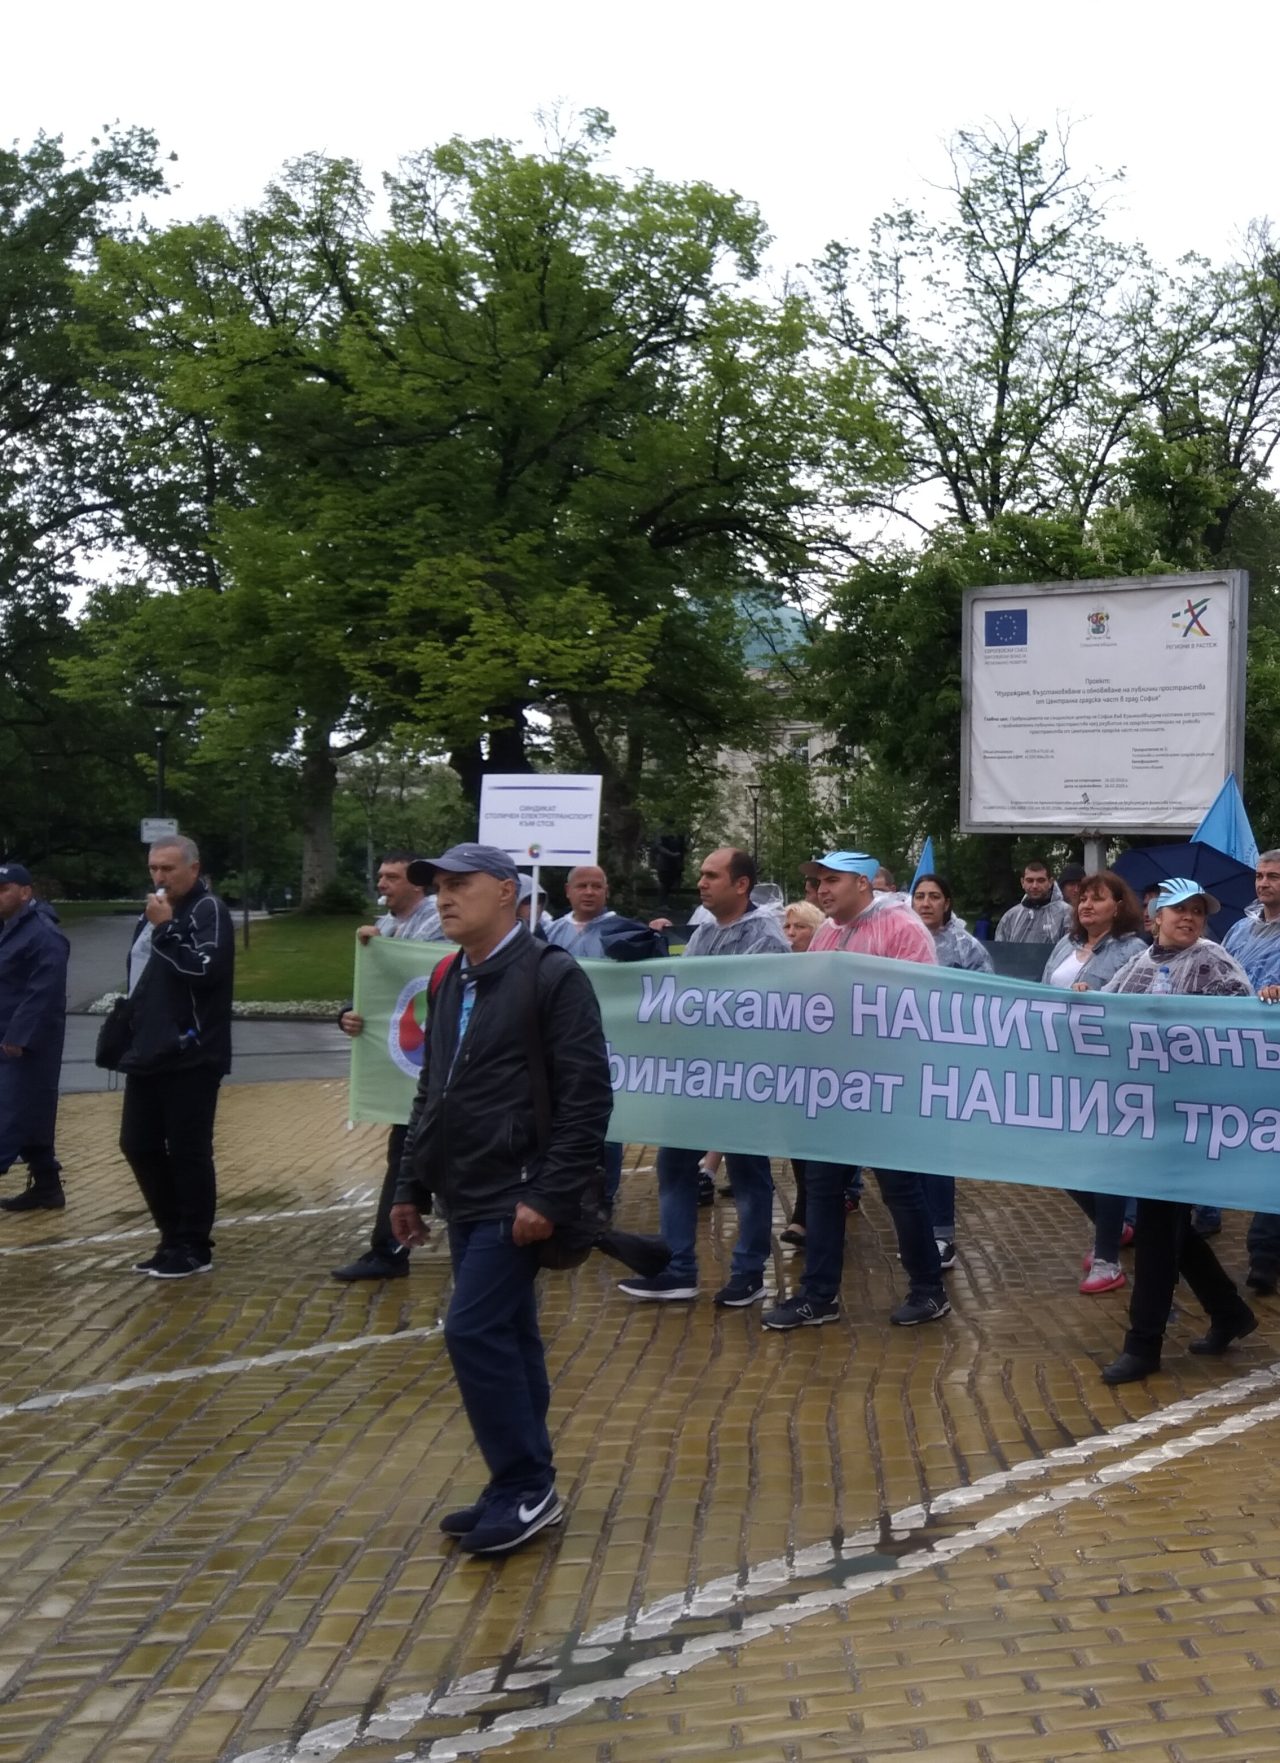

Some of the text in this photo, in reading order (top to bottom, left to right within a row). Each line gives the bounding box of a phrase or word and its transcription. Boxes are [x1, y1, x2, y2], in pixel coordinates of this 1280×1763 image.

[636, 974, 835, 1034] Искаме
[851, 982, 1111, 1057] НАШИТЕ
[919, 1063, 1155, 1140] НАШИЯ
